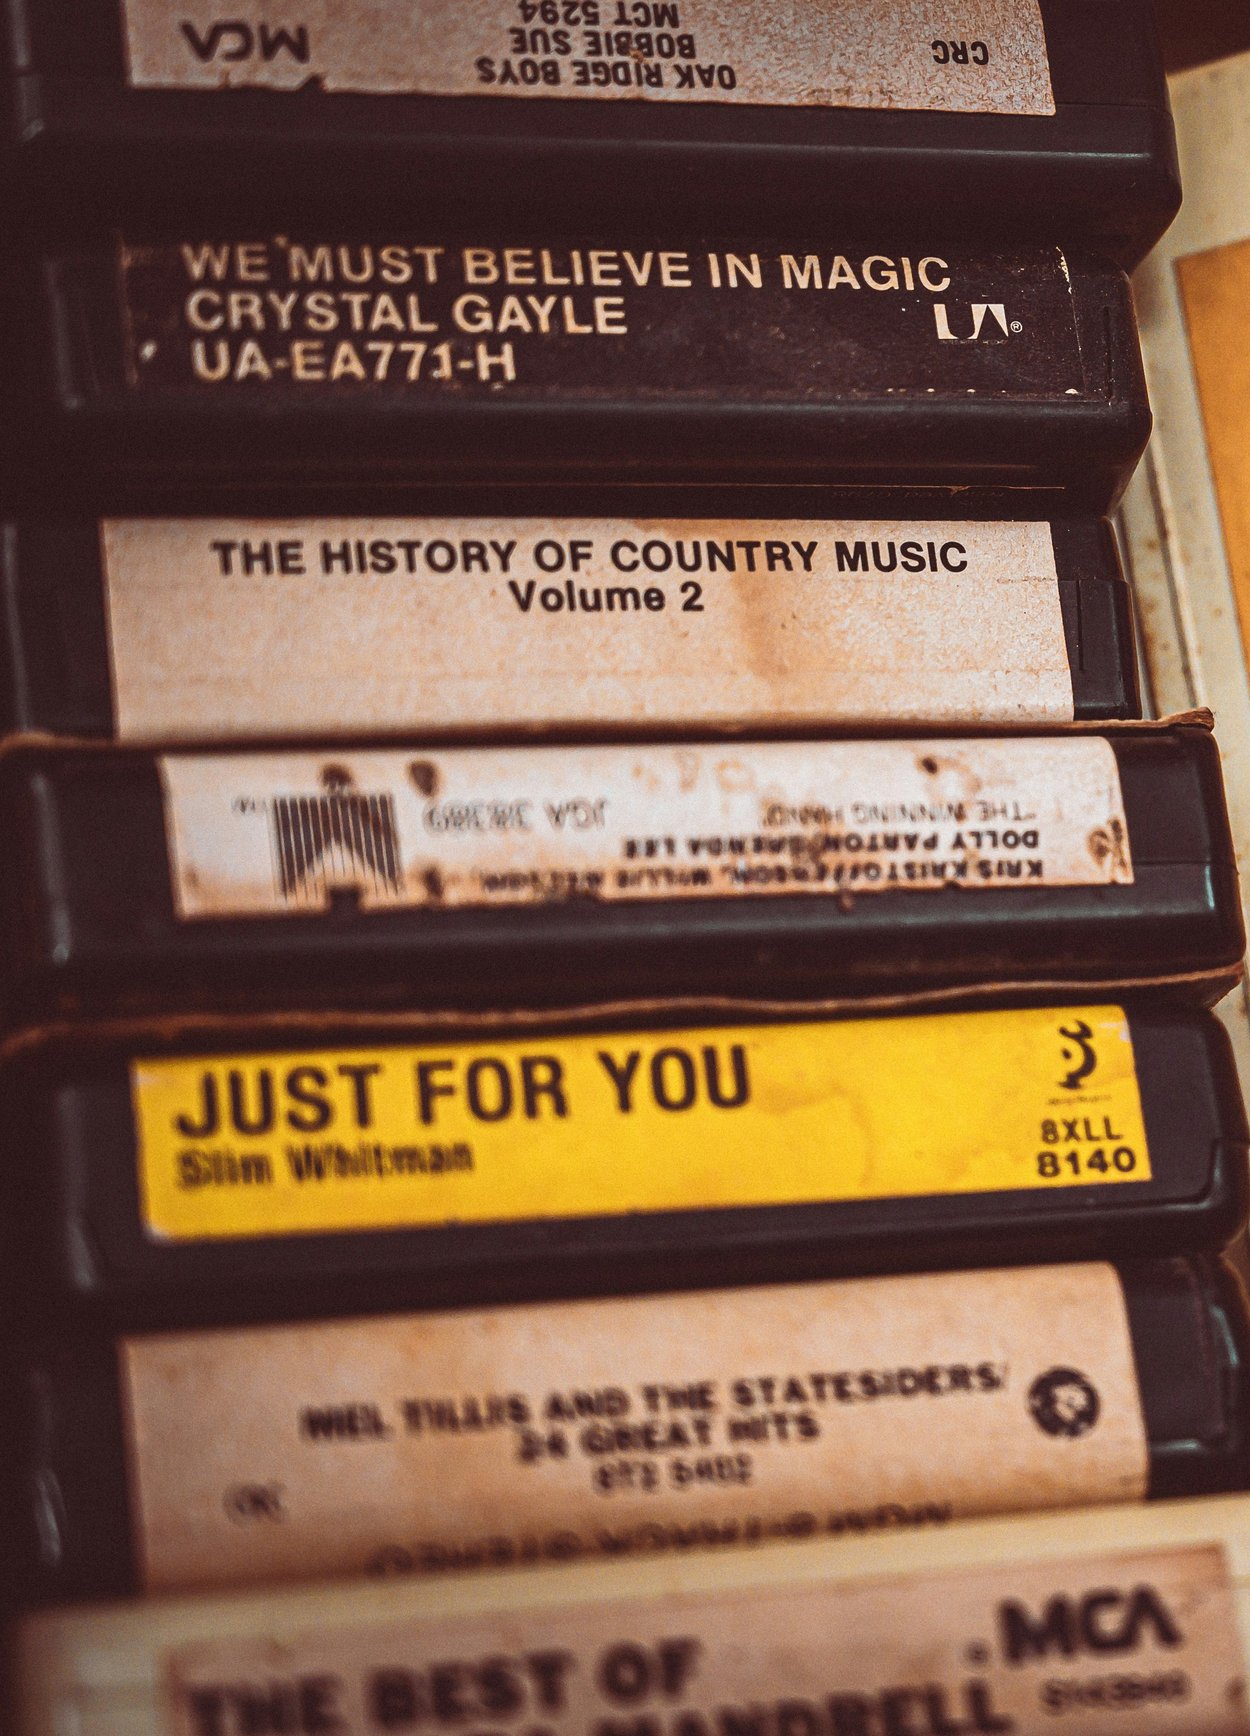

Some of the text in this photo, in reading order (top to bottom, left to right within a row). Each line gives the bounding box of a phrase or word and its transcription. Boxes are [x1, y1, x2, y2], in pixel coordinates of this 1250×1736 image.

[518, 0, 680, 29] MCT 5294
[182, 22, 310, 63] MCA
[511, 28, 697, 59] BOBBIE SUE
[931, 38, 990, 65] CRC
[477, 57, 737, 91] OAK RIDGE BOYS
[182, 243, 952, 293] WE MUST BELIEVE IN MAGIC
[184, 291, 628, 335] CRYSTAL GAYLE
[191, 340, 516, 383] UA-EA771-H
[213, 539, 969, 576] THE HISTORY OF COUNTRY MUSIC
[510, 579, 704, 613] Volume 2
[625, 836, 675, 859] LEE
[952, 830, 1039, 850] DOLLY
[978, 860, 1043, 880] KRIS
[173, 1044, 752, 1140] JUST FOR YOU
[1040, 1116, 1124, 1145] 8XLL
[175, 1139, 476, 1192] Slim Whitman
[1036, 1146, 1137, 1179] 8140
[401, 1393, 532, 1437] TILLIS
[543, 1386, 632, 1422] AND
[641, 1381, 716, 1414] THE
[516, 1411, 822, 1466] 24 GREAT HITS
[998, 1585, 1188, 1667] MCA
[188, 1635, 703, 1736] THE BEST OF
